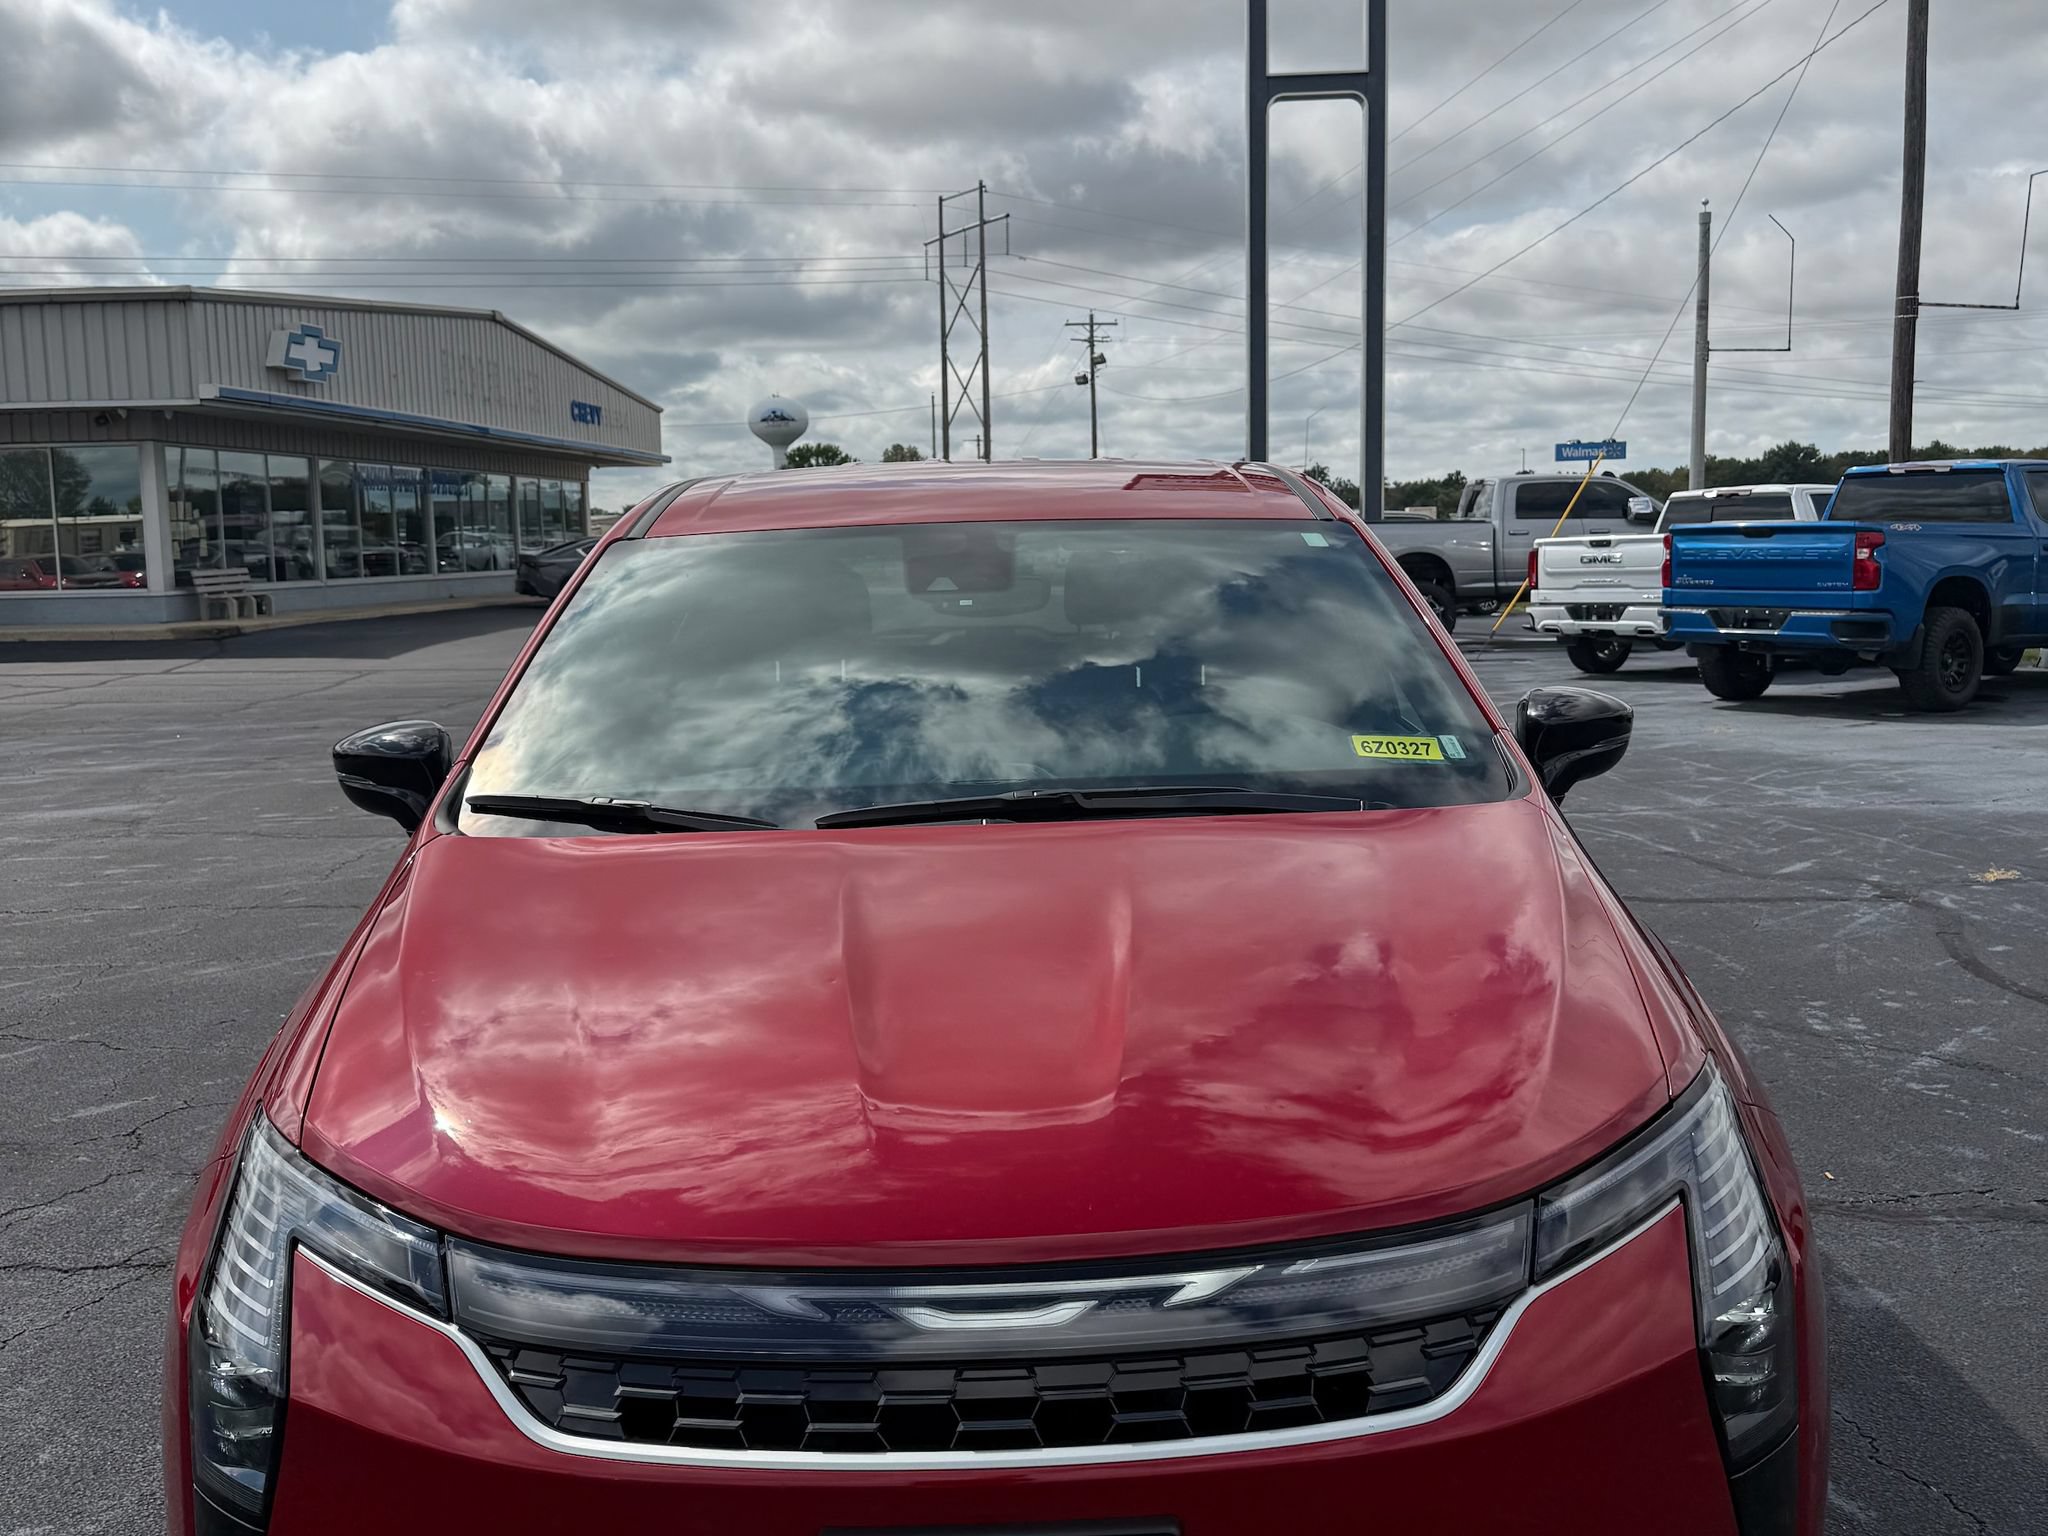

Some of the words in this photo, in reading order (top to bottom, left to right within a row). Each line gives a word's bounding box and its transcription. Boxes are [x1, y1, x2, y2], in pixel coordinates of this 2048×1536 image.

[571, 400, 602, 426] CHEVY
[1561, 446, 1608, 458] Walmart
[1580, 553, 1623, 564] GMC
[1681, 549, 1840, 560] CHEVROLET
[1361, 740, 1431, 756] 6Z0327
